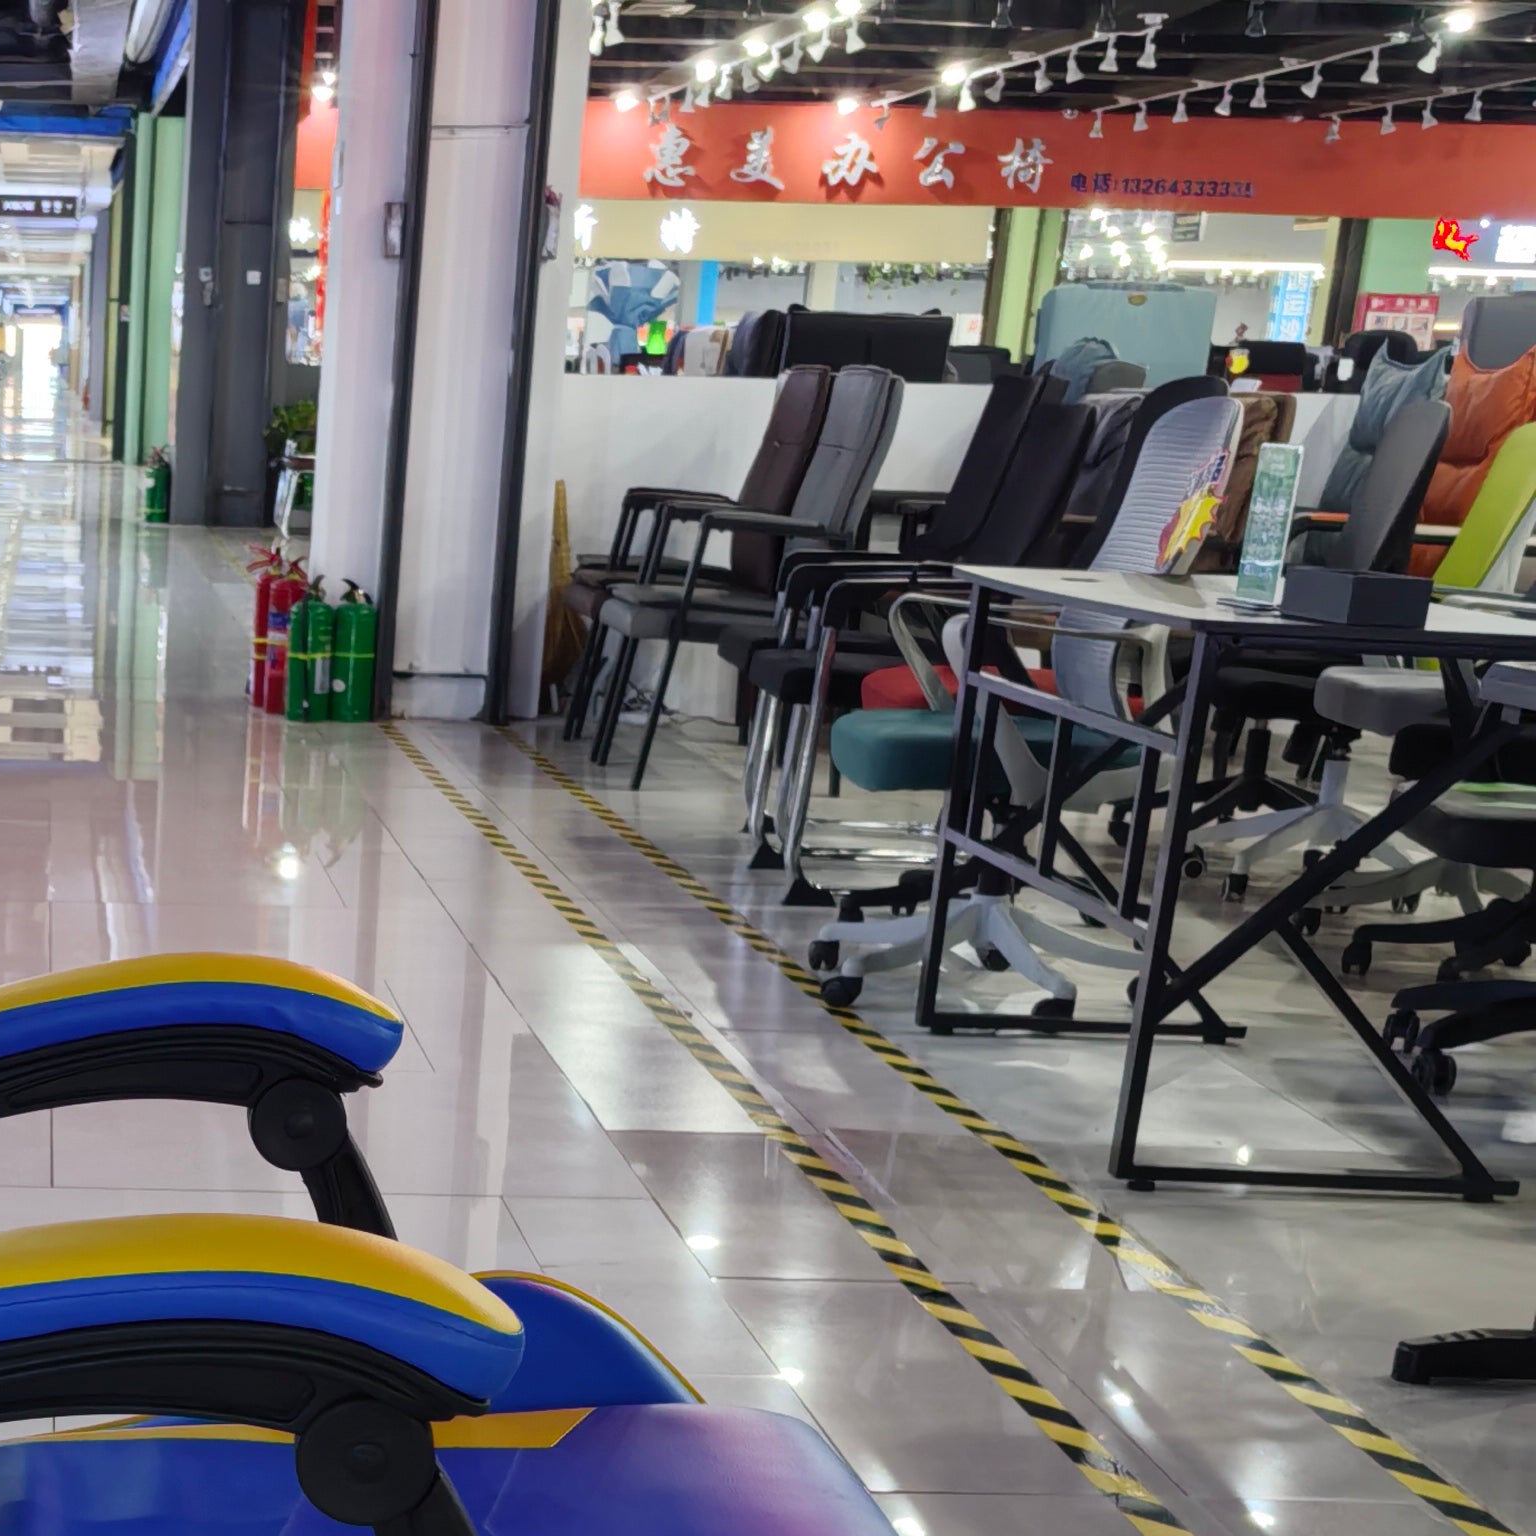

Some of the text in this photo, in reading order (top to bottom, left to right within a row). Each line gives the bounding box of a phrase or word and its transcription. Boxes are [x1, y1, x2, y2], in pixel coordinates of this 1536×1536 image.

[644, 123, 1054, 193] 惠美办公椅
